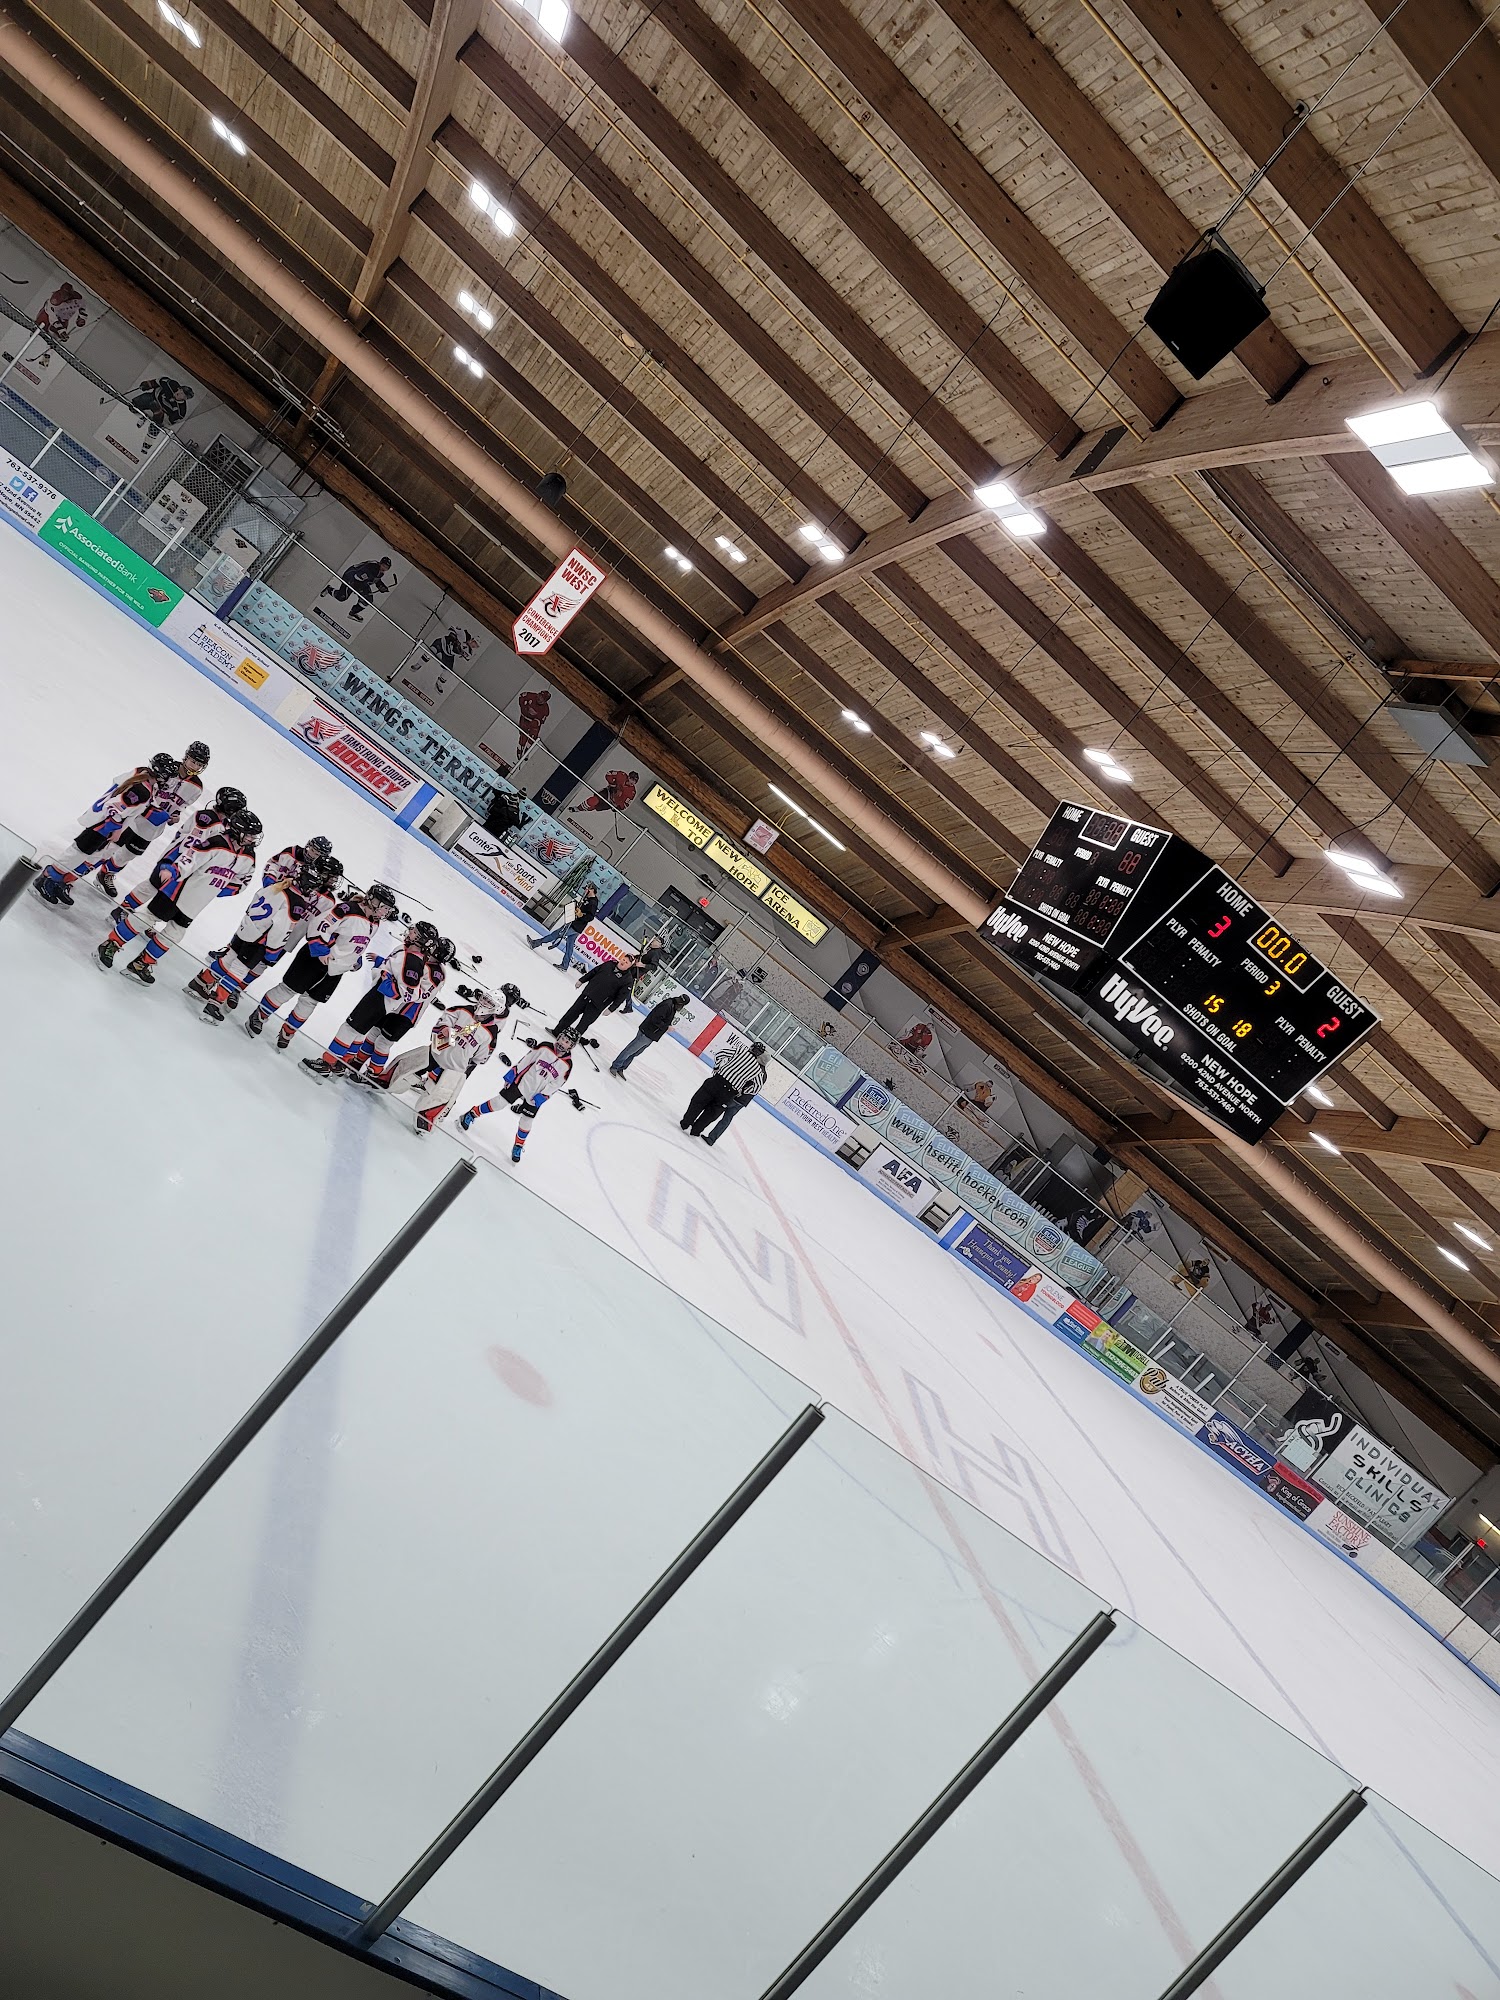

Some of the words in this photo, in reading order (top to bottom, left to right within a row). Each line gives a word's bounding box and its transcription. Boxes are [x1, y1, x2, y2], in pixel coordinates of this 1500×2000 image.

[2, 485, 17, 497] 42nd
[5, 457, 57, 500] 763-537-9376
[561, 568, 589, 595] WEST
[567, 558, 597, 586] NWSC
[522, 615, 553, 642] CHAMPIONS
[527, 608, 559, 636] CONFERENCE
[201, 635, 232, 661] BEACON
[519, 628, 540, 648] 2017
[197, 640, 235, 671] ACADEMY
[339, 671, 415, 739] WINGS
[325, 736, 402, 801] HOCKEY
[339, 731, 385, 769] ARMSTRONG
[380, 763, 411, 790] COOPER
[418, 735, 533, 833] TERRITY
[1061, 805, 1084, 822] HOME
[1128, 828, 1160, 848] GUEST
[468, 830, 494, 853] Center
[512, 862, 538, 885] Sports
[654, 788, 711, 838] WELCOME
[713, 839, 742, 864] NEW
[770, 886, 789, 904] ICE
[1031, 849, 1046, 860] PLYR
[1042, 853, 1063, 868] PENALTY
[1073, 846, 1093, 860] PERIOD
[513, 874, 533, 892] Mind
[685, 828, 704, 846] TO
[727, 865, 759, 893] HOPE
[763, 895, 802, 928] ARENA
[1094, 875, 1111, 888] PLYR
[1108, 881, 1133, 898] PENALTY
[1037, 901, 1054, 915] SHOTS
[1050, 909, 1061, 919] ON
[1057, 912, 1071, 924] GOAL
[1206, 913, 1233, 941] 3
[576, 933, 618, 968] DONU
[1041, 931, 1061, 949] NEW
[1056, 940, 1080, 959] HOPE
[1165, 917, 1187, 939] PLYR
[1187, 936, 1221, 969] PENALTY
[1216, 880, 1253, 918] HOME
[1325, 983, 1364, 1021] GUEST
[1254, 923, 1308, 977] 00.0
[1048, 948, 1065, 962] AVENUE
[1062, 957, 1080, 971] NORTH
[1240, 957, 1269, 985] PERIOD
[1263, 977, 1282, 998] 3
[1201, 992, 1225, 1015] 15
[1181, 1002, 1209, 1028] SHOTS
[1205, 1022, 1219, 1038] ON
[1215, 1031, 1238, 1054] GOAL
[1229, 1016, 1253, 1040] 18
[1274, 1015, 1295, 1037] PLYR
[1294, 1033, 1326, 1065] PENALTY
[1315, 1012, 1342, 1042] 2
[1178, 1052, 1199, 1071] 8200
[1195, 1066, 1216, 1085] 42ND
[1213, 1080, 1241, 1106] AVENUE
[1237, 1101, 1262, 1125] NORTH
[1199, 1053, 1229, 1082] NEW
[1225, 1075, 1258, 1106] HOPE
[1193, 1077, 1236, 1114] 763-531-7460
[781, 1098, 801, 1115] ACHIEVE
[799, 1111, 812, 1124] YOUR
[810, 1121, 823, 1132] BEST
[820, 1129, 838, 1144] HEALTH
[787, 1087, 847, 1138] PreferredOne
[900, 1113, 926, 1128] ELITE
[936, 1142, 961, 1156] ELITE
[882, 1156, 924, 1193] AFA
[971, 1169, 995, 1184] ELITE
[966, 1238, 995, 1263] Hennepin
[991, 1258, 1017, 1281] County!
[982, 1238, 1003, 1257] Thank
[999, 1254, 1012, 1266] you
[1063, 1256, 1092, 1273] LEAGUE
[1070, 1249, 1093, 1264] ELITE
[1039, 1288, 1064, 1309] YOUNGBLOOD
[1043, 1282, 1065, 1302] JOLENE
[1141, 1365, 1170, 1391] Pub
[1187, 1393, 1199, 1404] POWER
[1225, 1437, 1265, 1471] ACYHA
[1349, 1431, 1444, 1511] INDIVIDUAL
[1349, 1452, 1425, 1514] SKILLS
[1279, 1485, 1293, 1498] King
[1291, 1493, 1300, 1502] of
[1296, 1498, 1312, 1513] Grace
[1343, 1467, 1411, 1523] CLINICS
[1328, 1518, 1364, 1548] FACTORY
[1333, 1510, 1371, 1543] SUNSHINE
